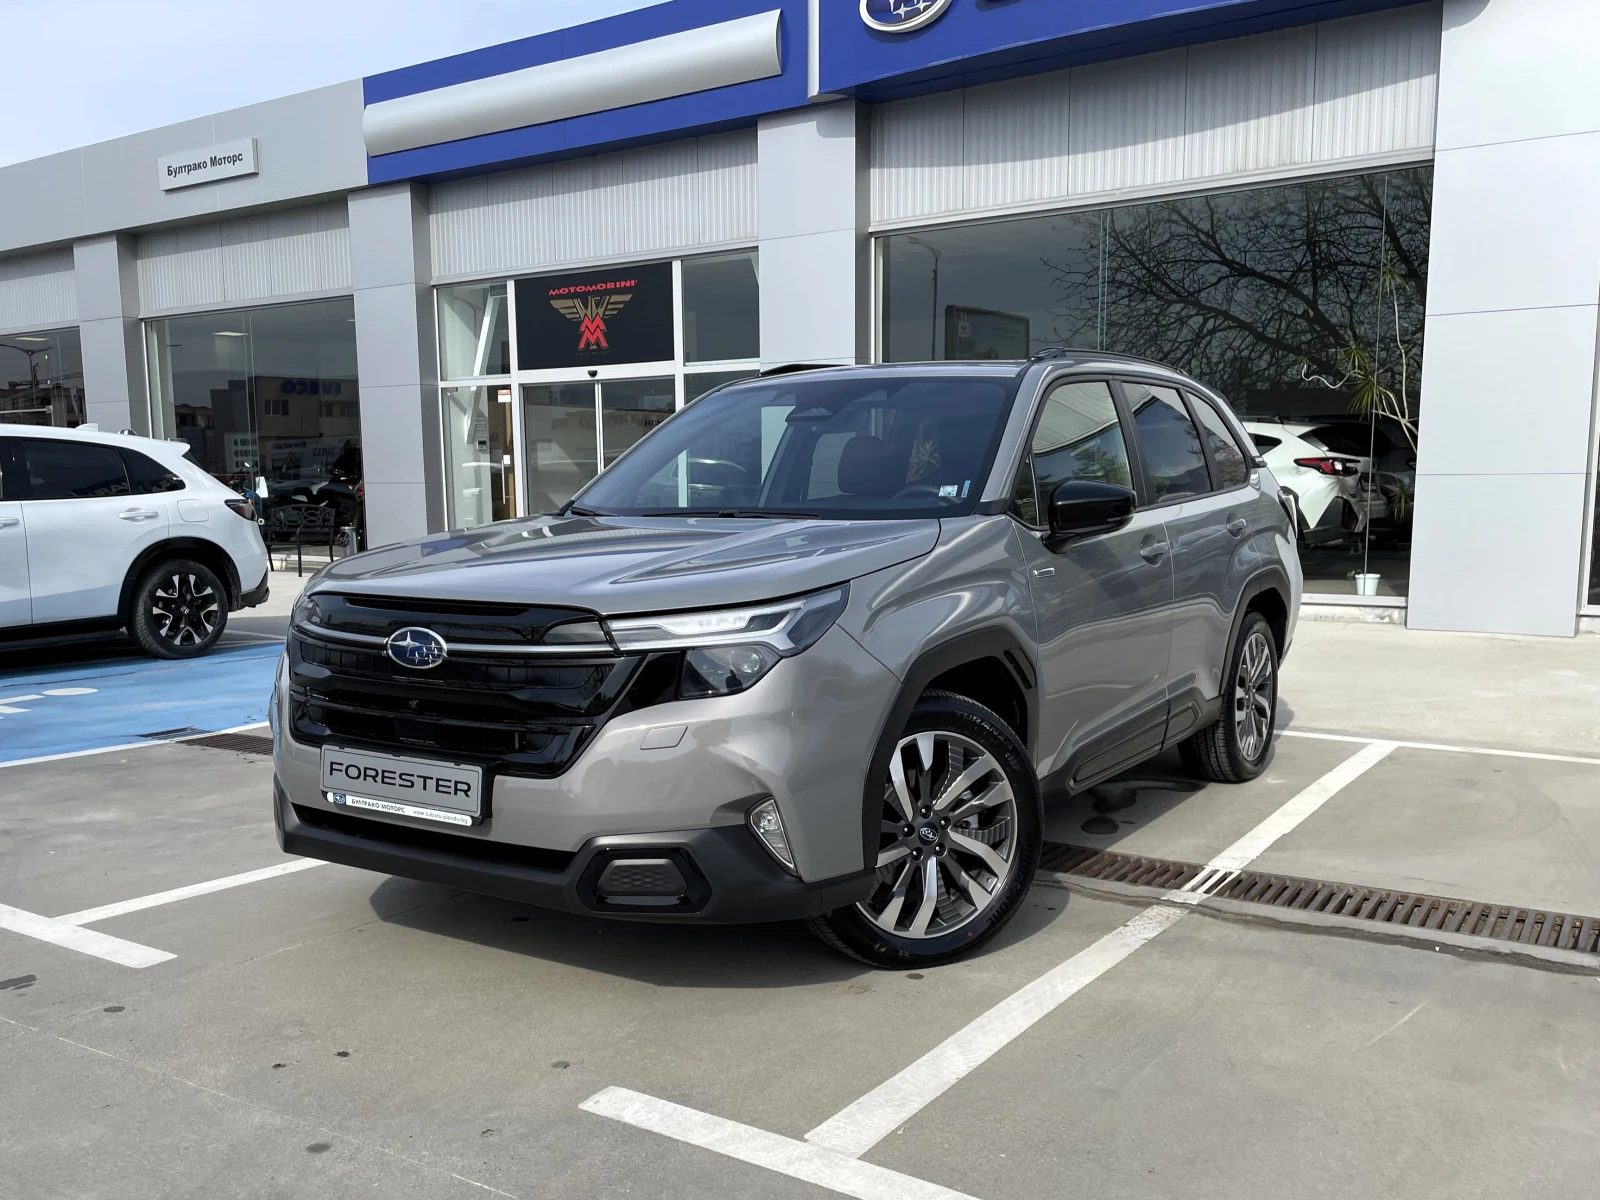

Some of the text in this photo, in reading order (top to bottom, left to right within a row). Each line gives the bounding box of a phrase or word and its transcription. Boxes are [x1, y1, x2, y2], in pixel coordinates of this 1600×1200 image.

[167, 152, 243, 178] Бултрако Моторс
[329, 761, 472, 798] FORESTER
[351, 798, 405, 813] БУЛТРАКО МОТОРС
